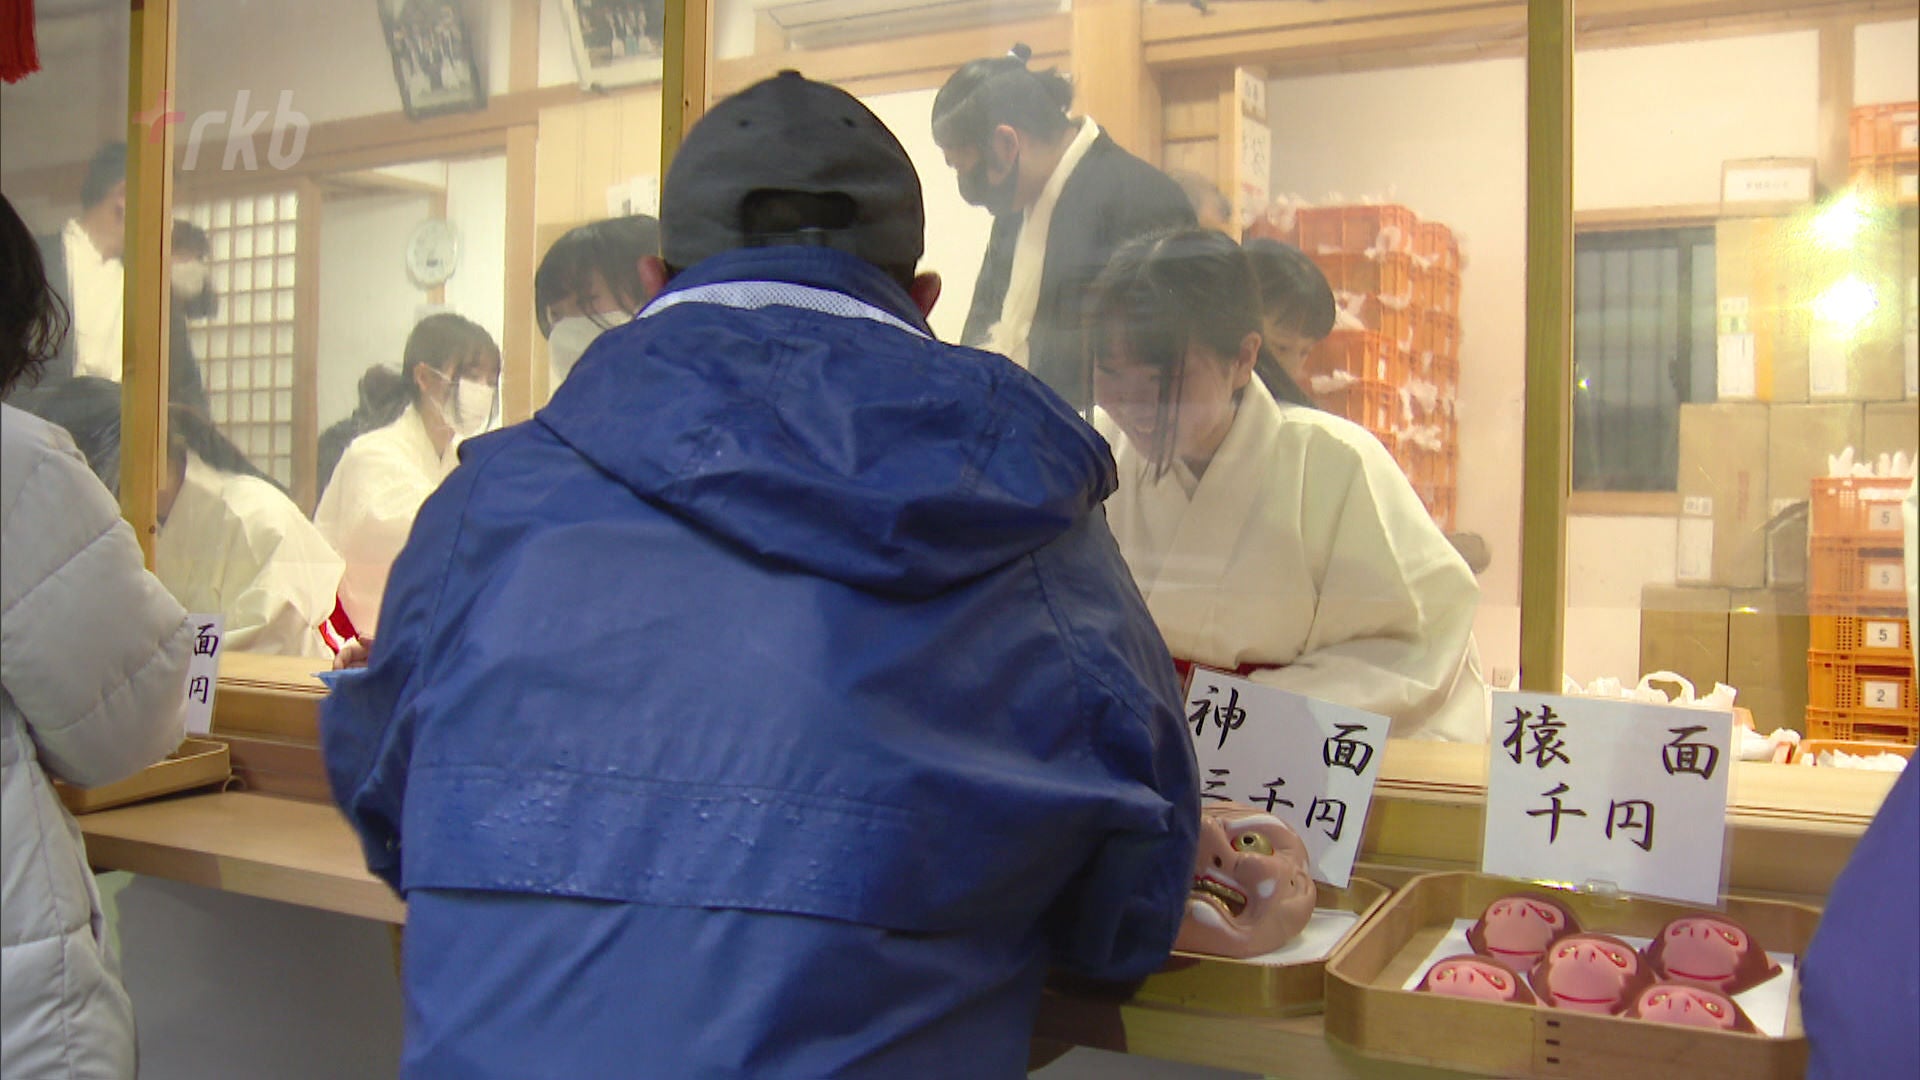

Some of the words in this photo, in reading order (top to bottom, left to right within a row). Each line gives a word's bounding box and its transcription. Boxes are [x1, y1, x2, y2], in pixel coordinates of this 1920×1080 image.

[1880, 511, 1891, 525] 5
[193, 623, 219, 658] 面
[1878, 628, 1888, 642] 5
[189, 676, 209, 704] 円
[1876, 689, 1886, 703] 2
[1526, 782, 1655, 852] 千円
